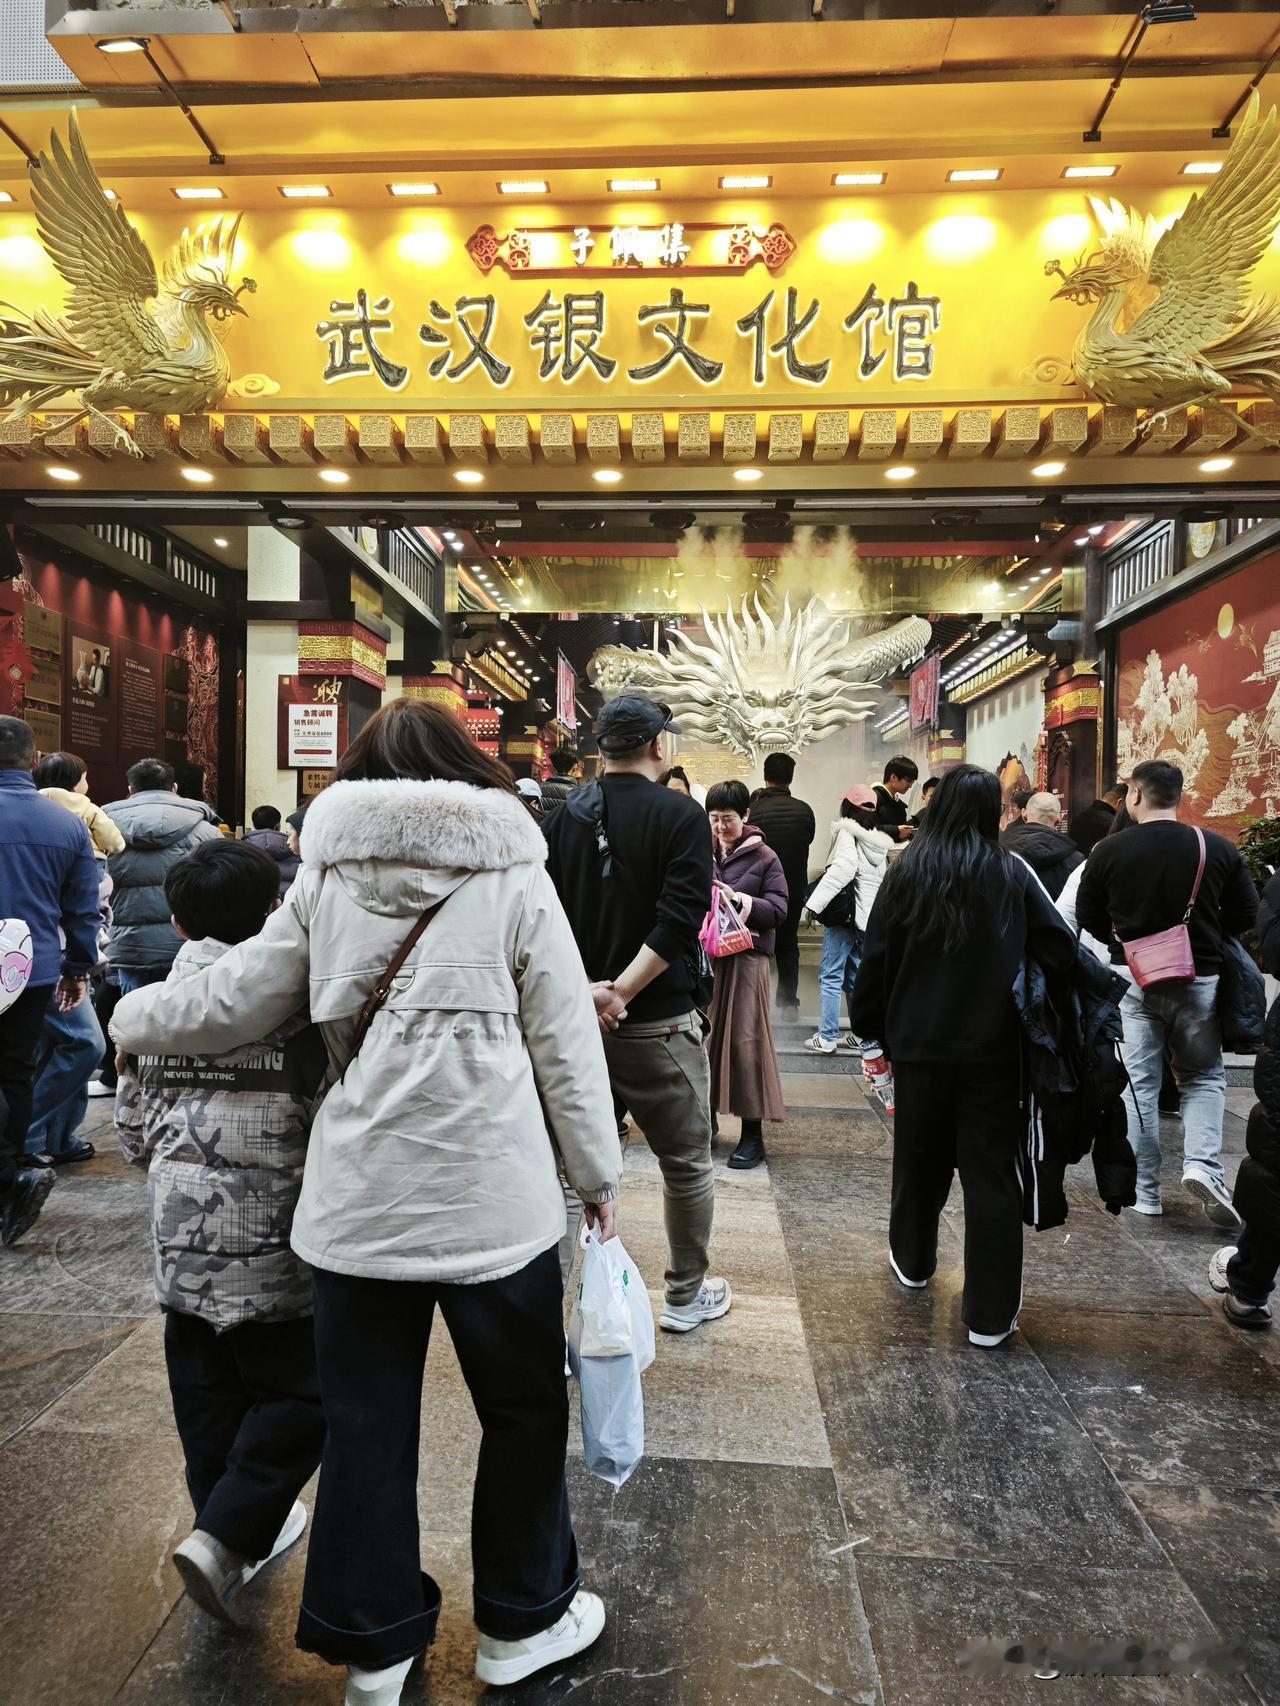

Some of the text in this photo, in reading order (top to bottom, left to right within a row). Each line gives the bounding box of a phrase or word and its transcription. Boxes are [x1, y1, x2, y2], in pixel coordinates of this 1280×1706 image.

[316, 281, 941, 388] 武汉银文化馆
[163, 1070, 194, 1079] NEVER
